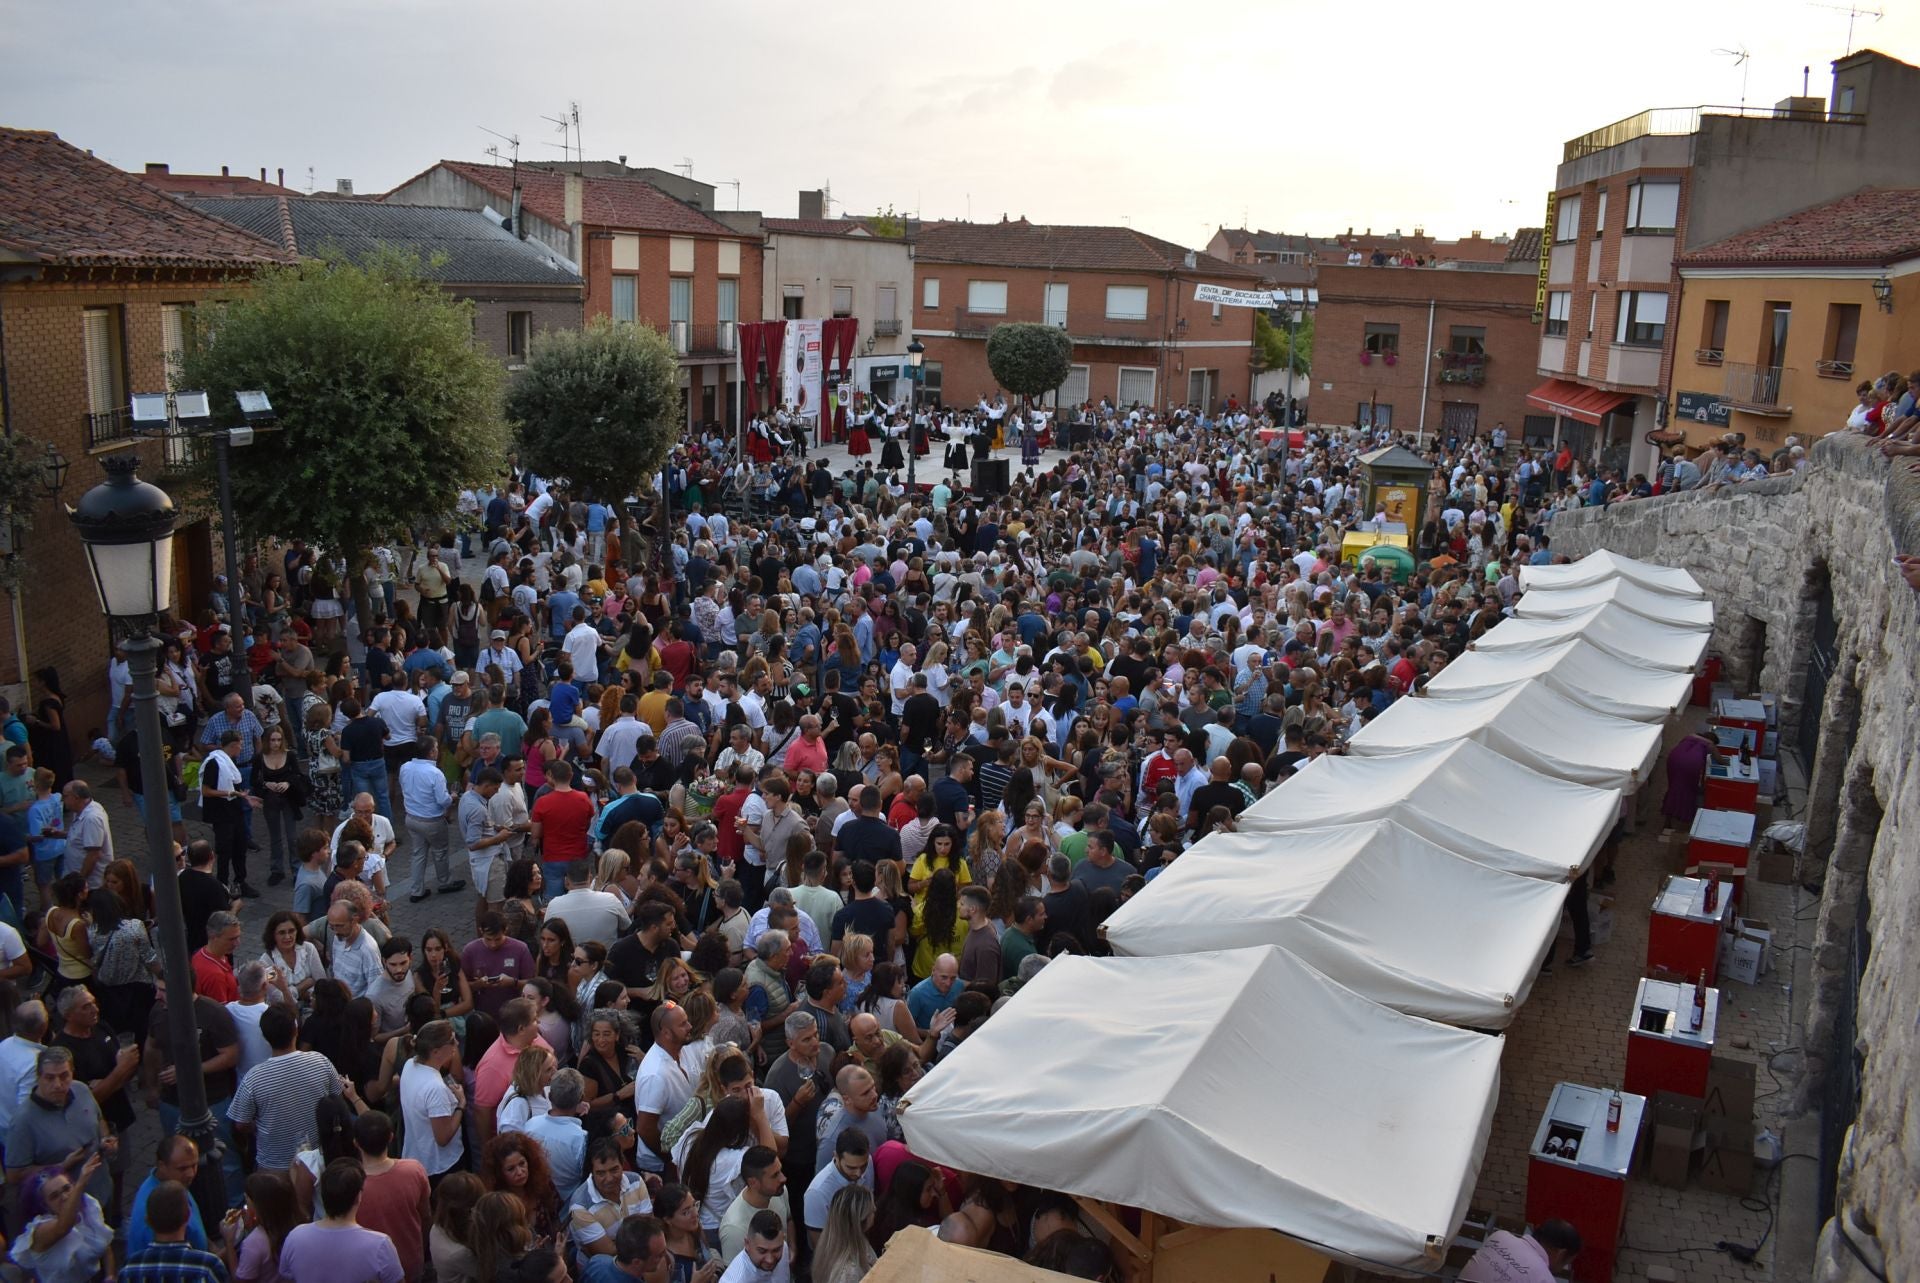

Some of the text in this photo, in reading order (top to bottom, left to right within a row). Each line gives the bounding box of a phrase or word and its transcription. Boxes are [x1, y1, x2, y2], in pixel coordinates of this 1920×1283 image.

[1537, 192, 1556, 311] CHARCUTERIA
[1200, 286, 1218, 294] VENTA
[1199, 293, 1242, 304] CHARCUTERIA
[1682, 396, 1691, 406] BAR
[449, 705, 462, 716] RIO
